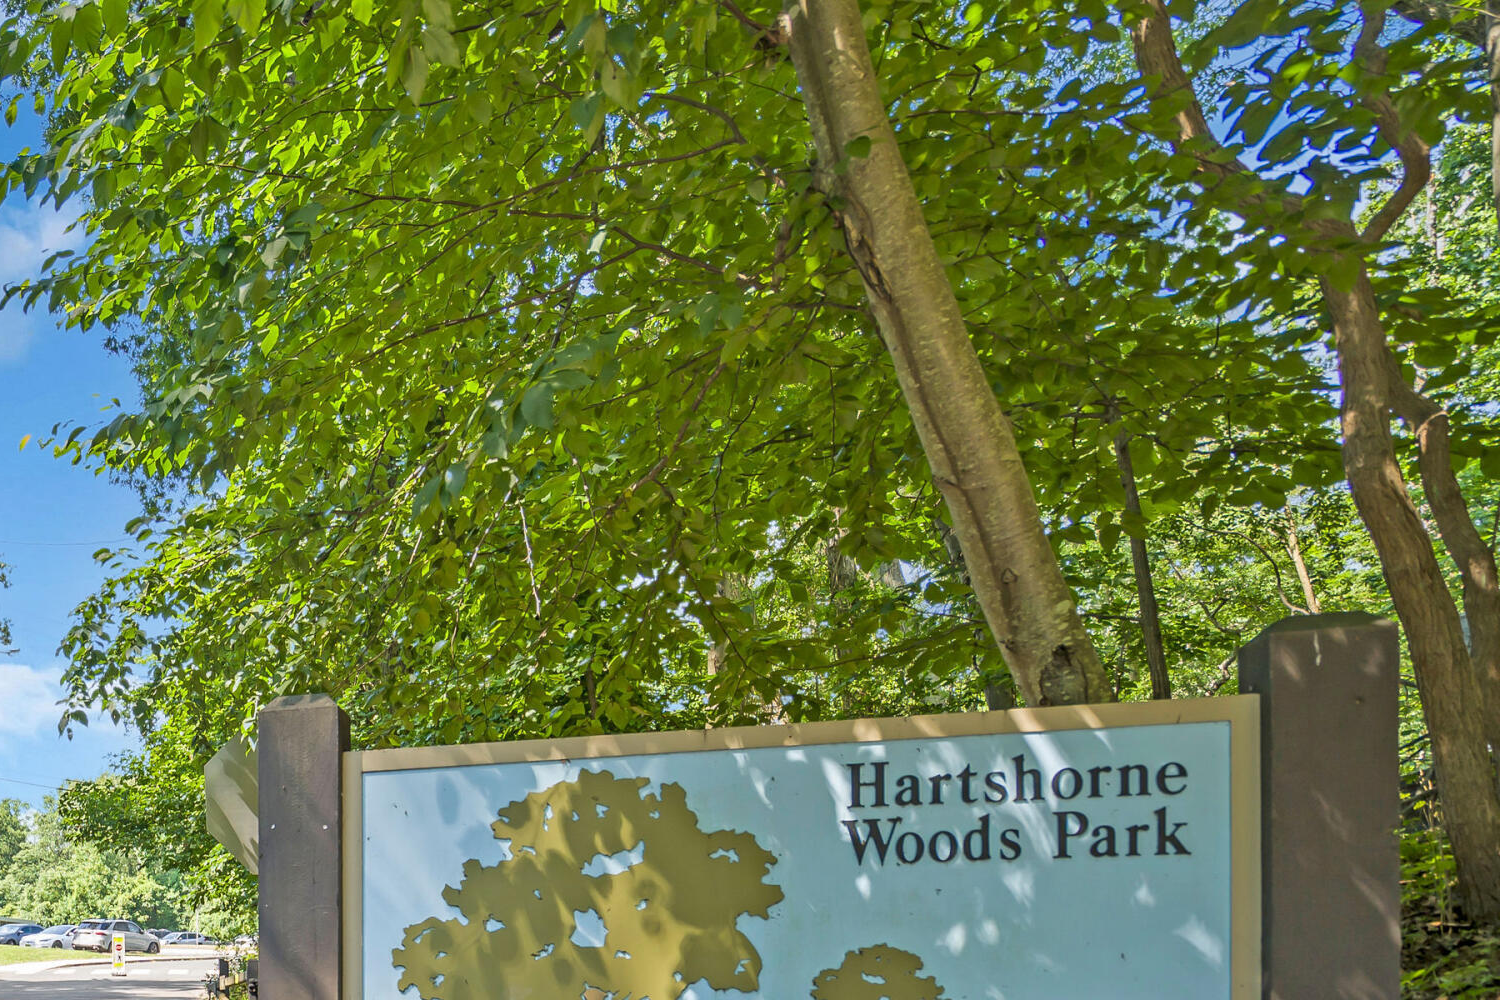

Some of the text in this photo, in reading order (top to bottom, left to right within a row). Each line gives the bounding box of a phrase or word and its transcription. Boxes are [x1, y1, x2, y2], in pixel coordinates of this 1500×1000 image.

[846, 753, 1189, 809] Hartshorne
[842, 806, 1192, 867] Woods Park
